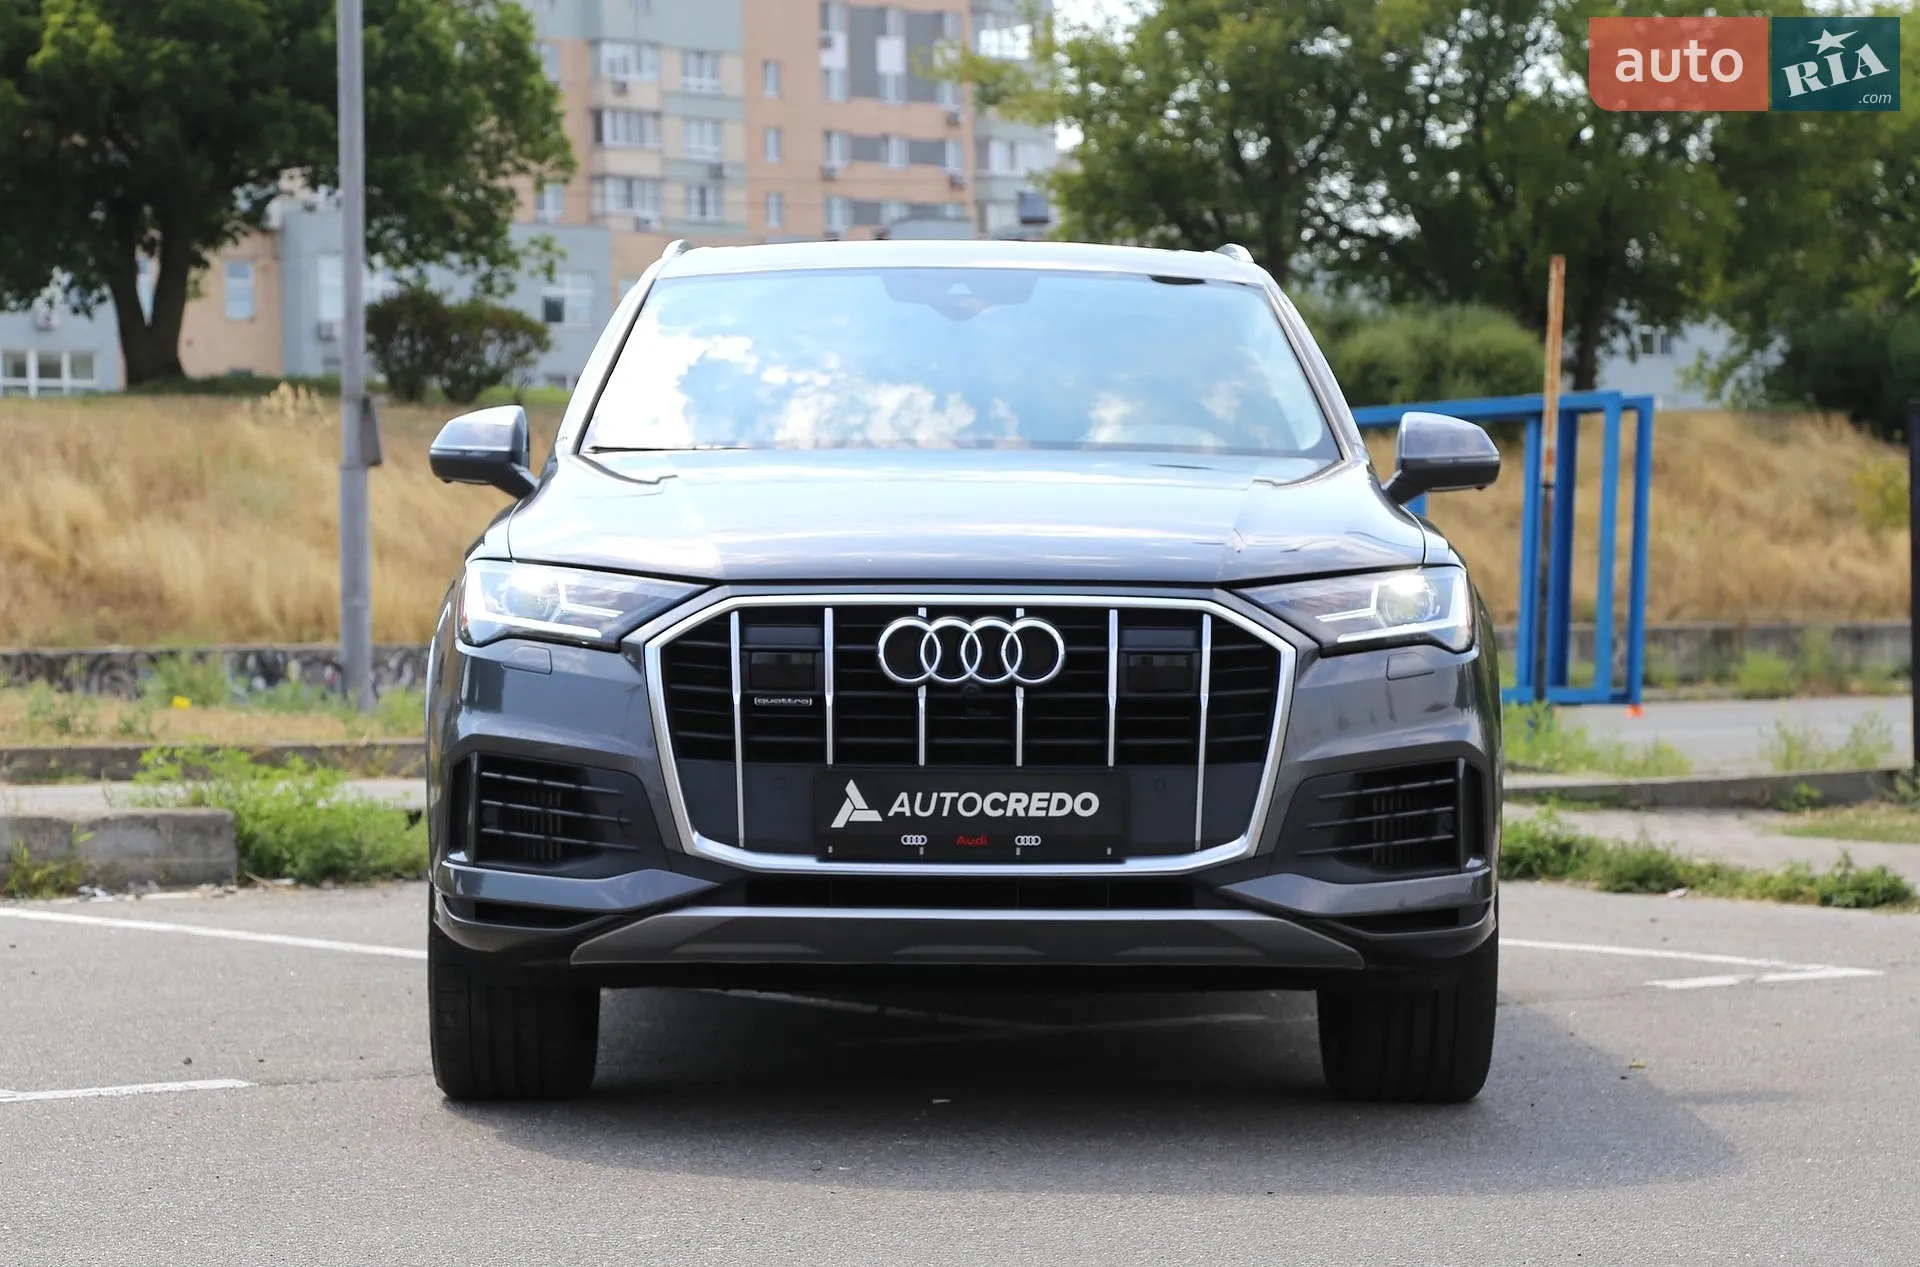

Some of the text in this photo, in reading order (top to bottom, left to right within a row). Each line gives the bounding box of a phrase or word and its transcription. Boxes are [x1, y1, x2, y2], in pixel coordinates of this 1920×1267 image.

[756, 697, 810, 706] quattro
[887, 791, 1100, 818] AUTOCREDO
[955, 834, 989, 846] Audi
